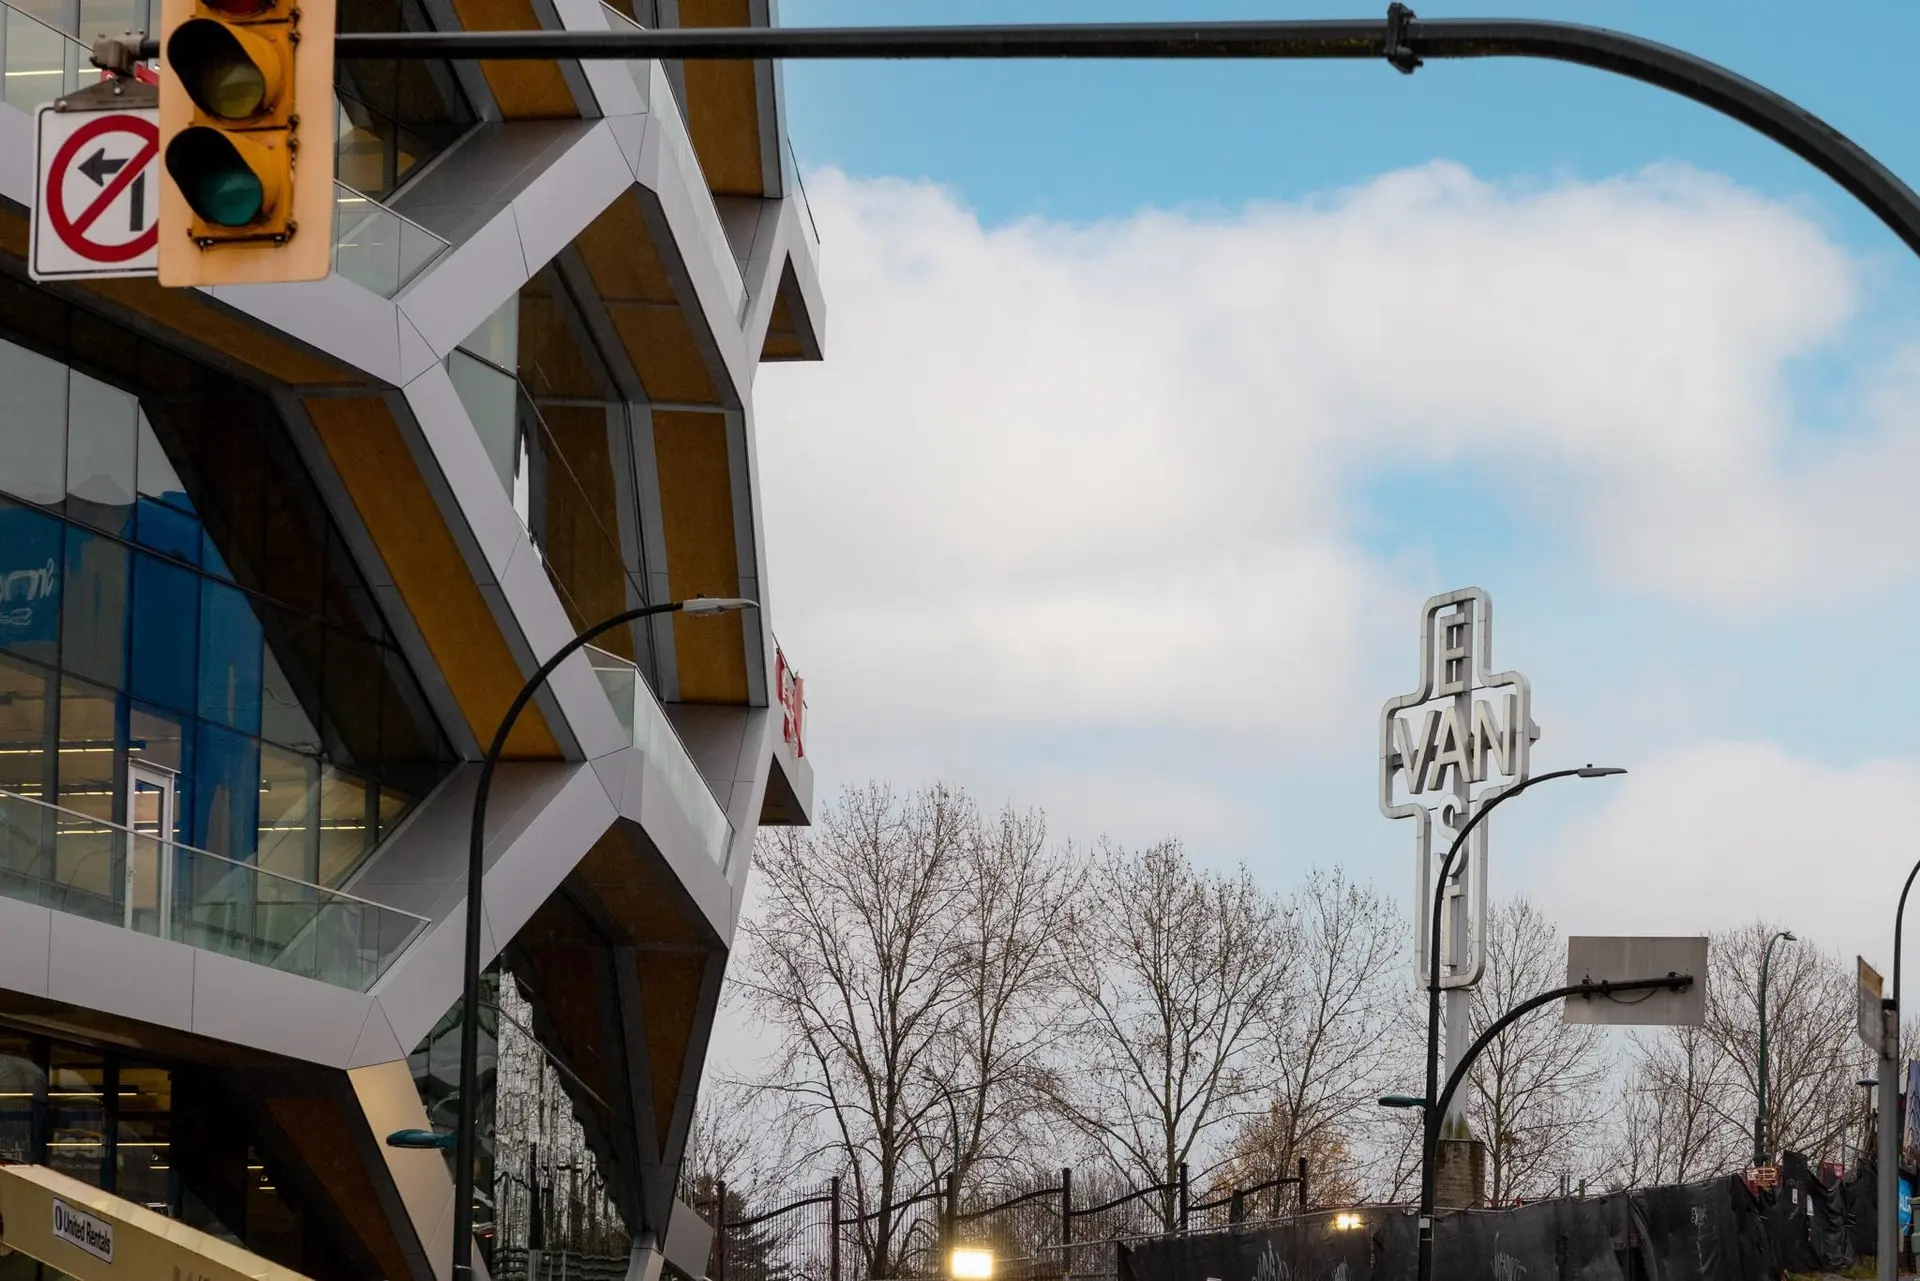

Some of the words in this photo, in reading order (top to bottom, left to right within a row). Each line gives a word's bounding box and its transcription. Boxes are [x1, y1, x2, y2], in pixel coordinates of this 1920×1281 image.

[1393, 693, 1518, 796] VAN
[64, 1210, 85, 1241] United
[87, 1221, 110, 1254] Rentals
